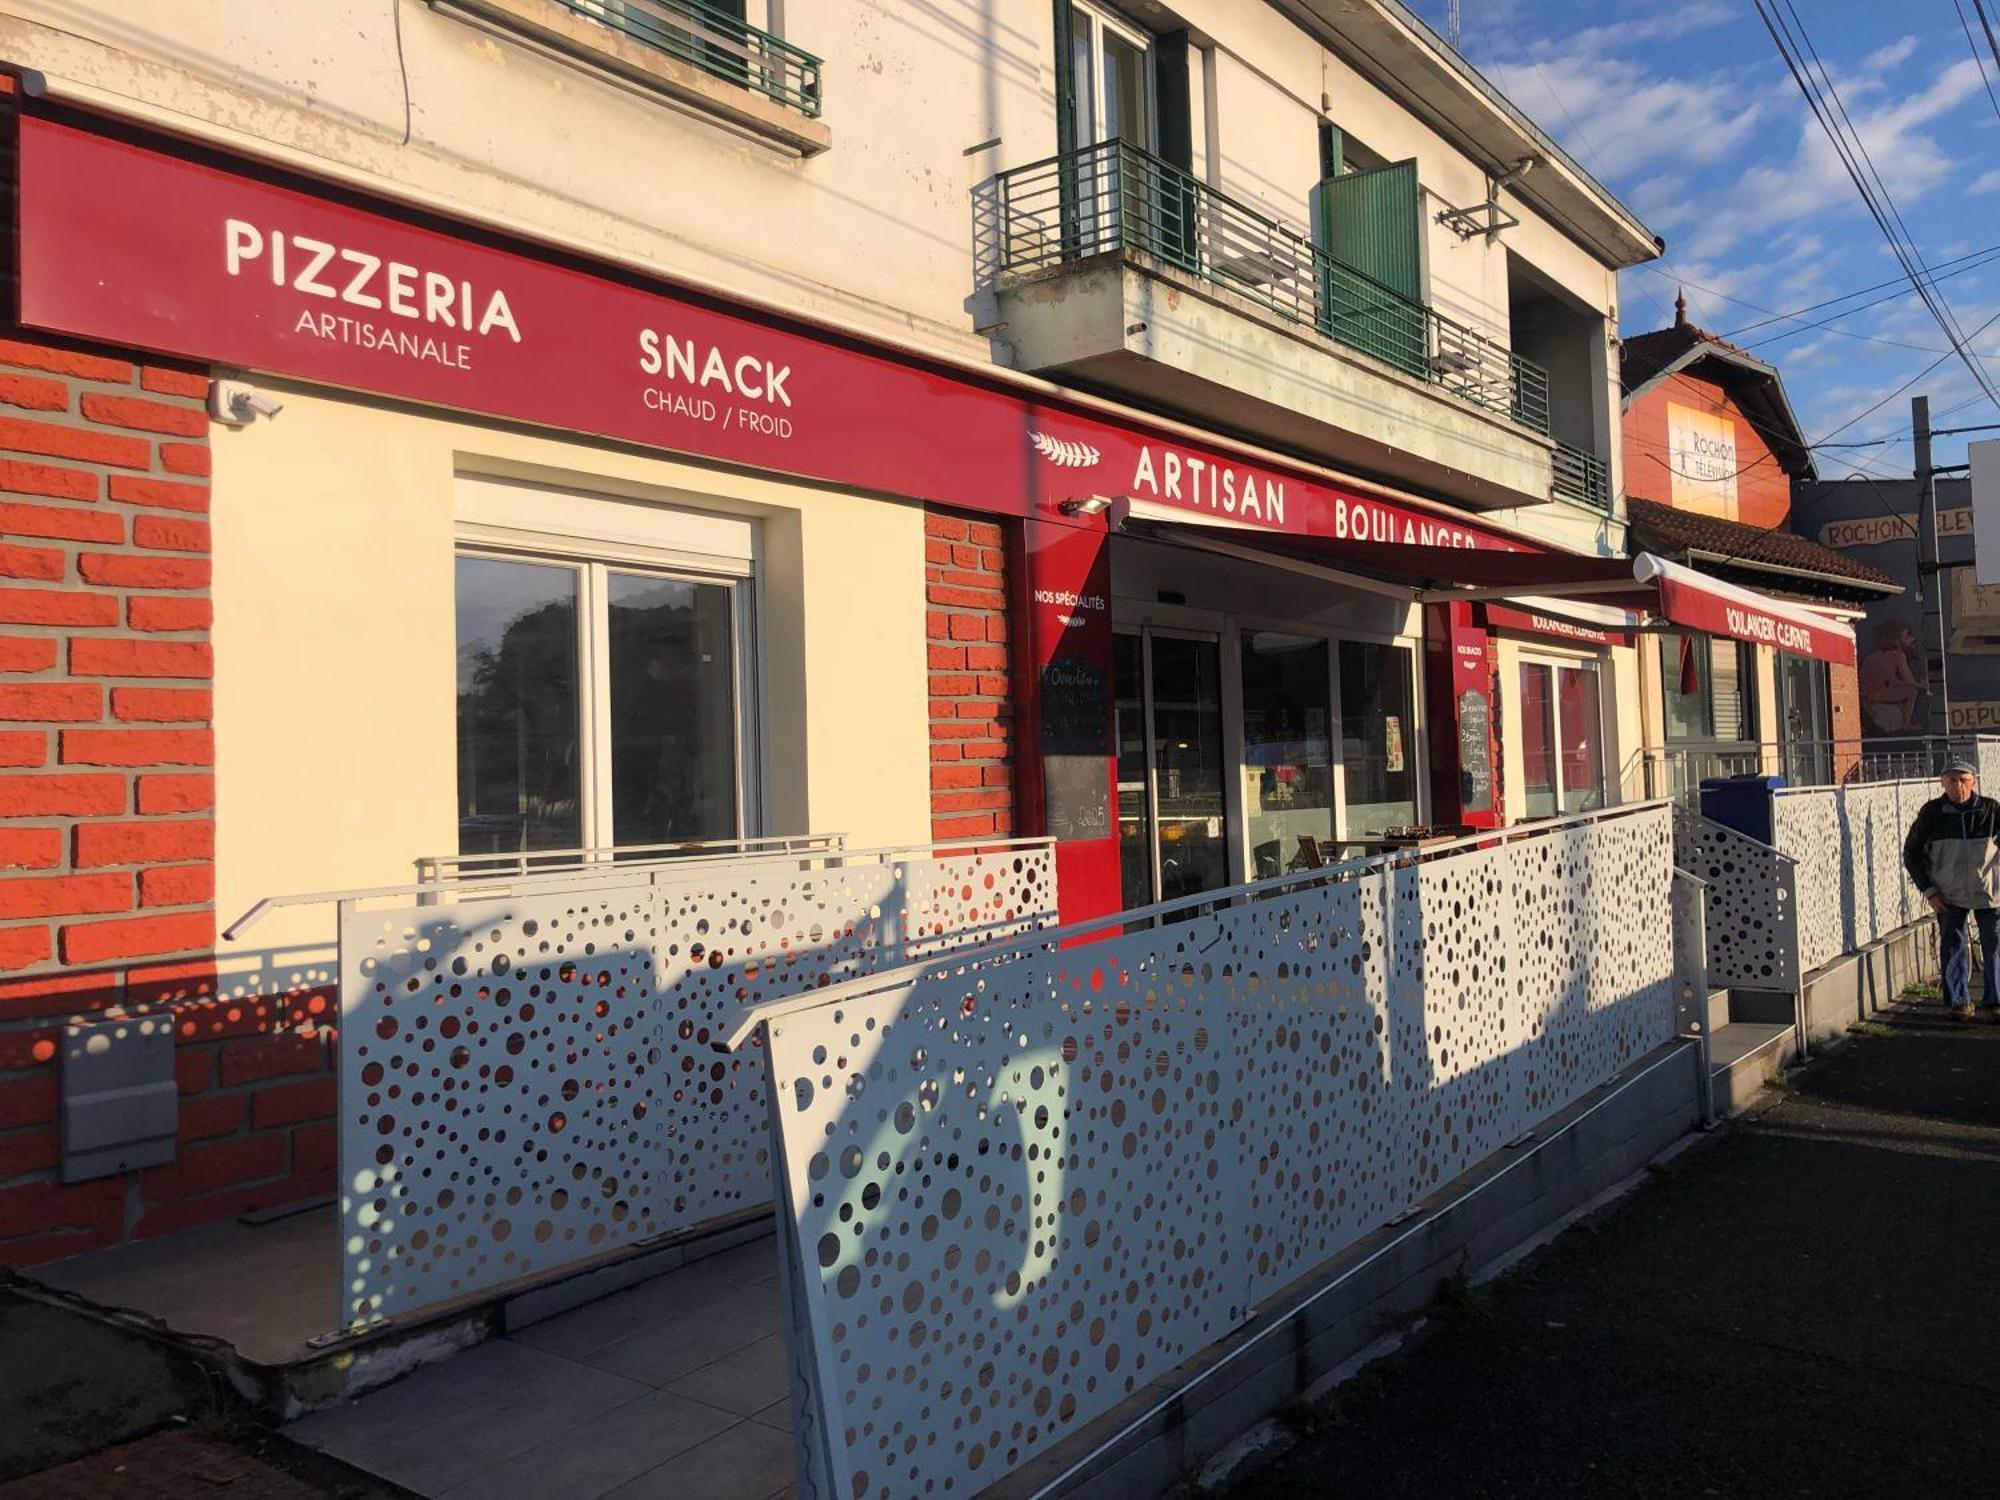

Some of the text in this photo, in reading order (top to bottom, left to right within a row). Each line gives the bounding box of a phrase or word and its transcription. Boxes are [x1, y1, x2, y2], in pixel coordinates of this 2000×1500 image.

[225, 218, 523, 344] PIZZERIA
[294, 309, 472, 371] ARTISANALE
[639, 328, 793, 408] SNACK
[643, 388, 793, 439] CHAUD / FROID
[1134, 446, 1285, 524] ARTISAN
[1828, 521, 1904, 545] ROCHON
[1035, 590, 1105, 610] NOS SPÉCIALITÉS
